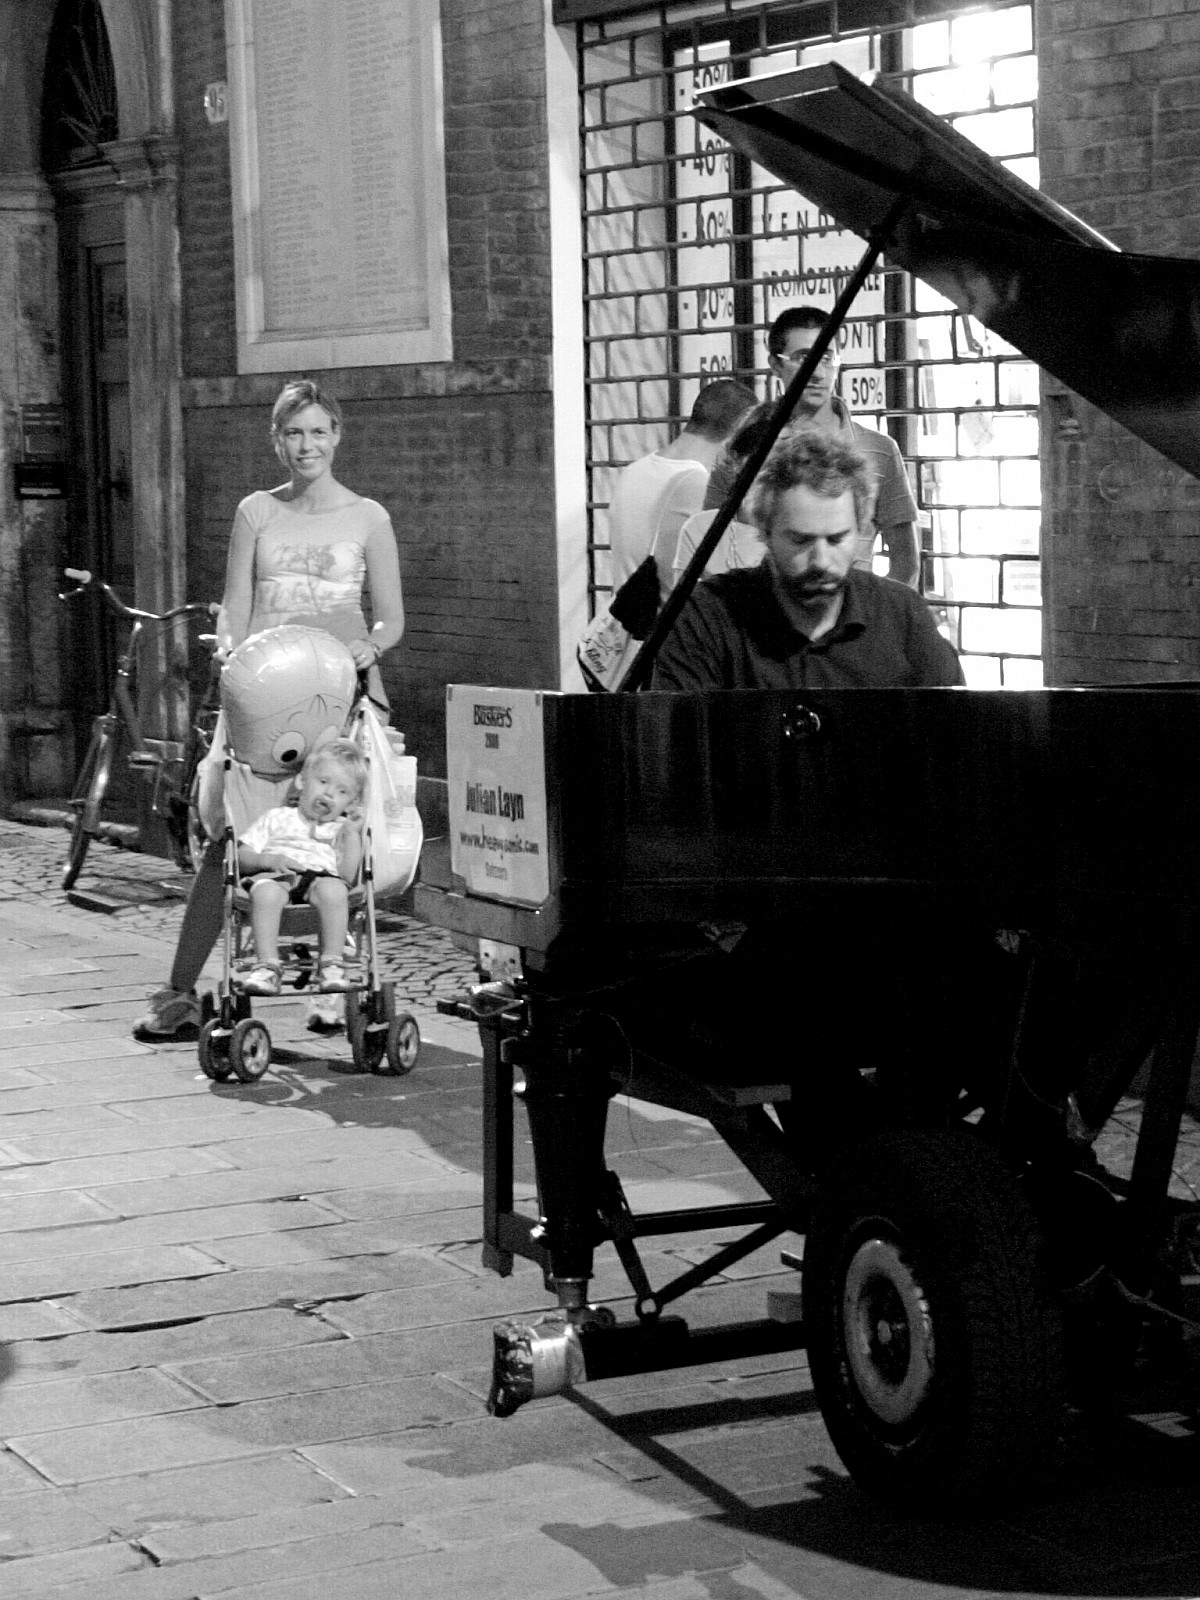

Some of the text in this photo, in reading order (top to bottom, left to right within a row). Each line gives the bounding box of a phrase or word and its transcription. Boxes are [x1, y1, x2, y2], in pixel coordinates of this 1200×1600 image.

[850, 376, 883, 406] 50%
[466, 780, 525, 822] Julian Layn
